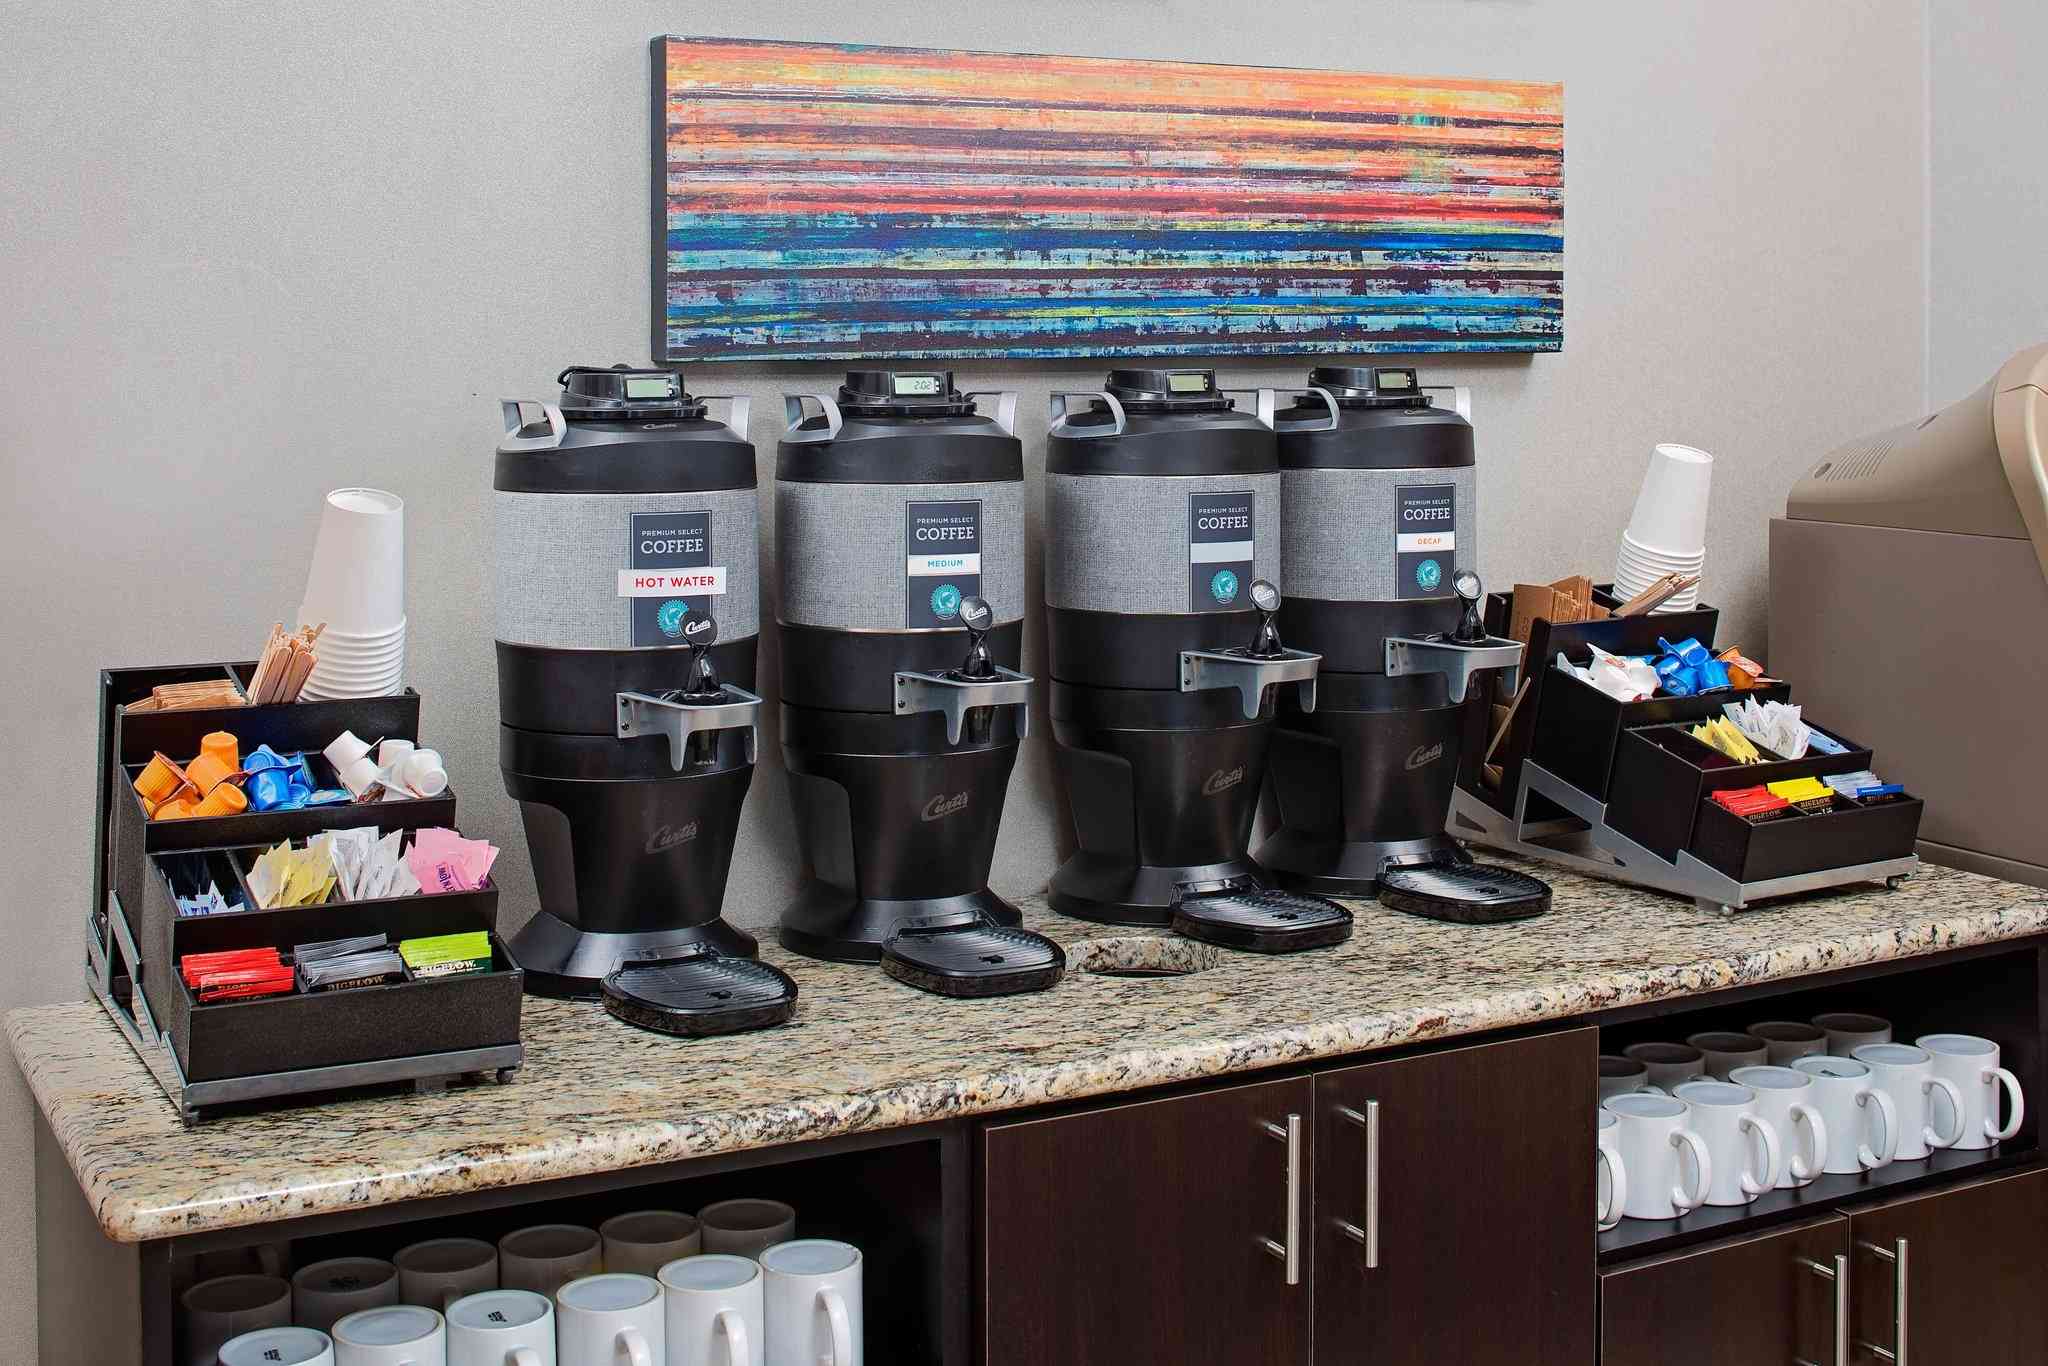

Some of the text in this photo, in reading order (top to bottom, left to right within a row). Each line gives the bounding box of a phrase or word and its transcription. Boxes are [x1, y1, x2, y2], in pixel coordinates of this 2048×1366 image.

[1404, 507, 1451, 520] COFFEE
[916, 517, 950, 525] PREMIUM
[1198, 516, 1249, 530] COFFEE
[641, 528, 704, 537] PREMIUM SELECT
[916, 526, 975, 541] COFFEE
[640, 538, 704, 554] COFFEE
[1417, 537, 1442, 545] DECAF
[927, 559, 963, 568] MEDIUM
[635, 575, 715, 588] HOT WATER
